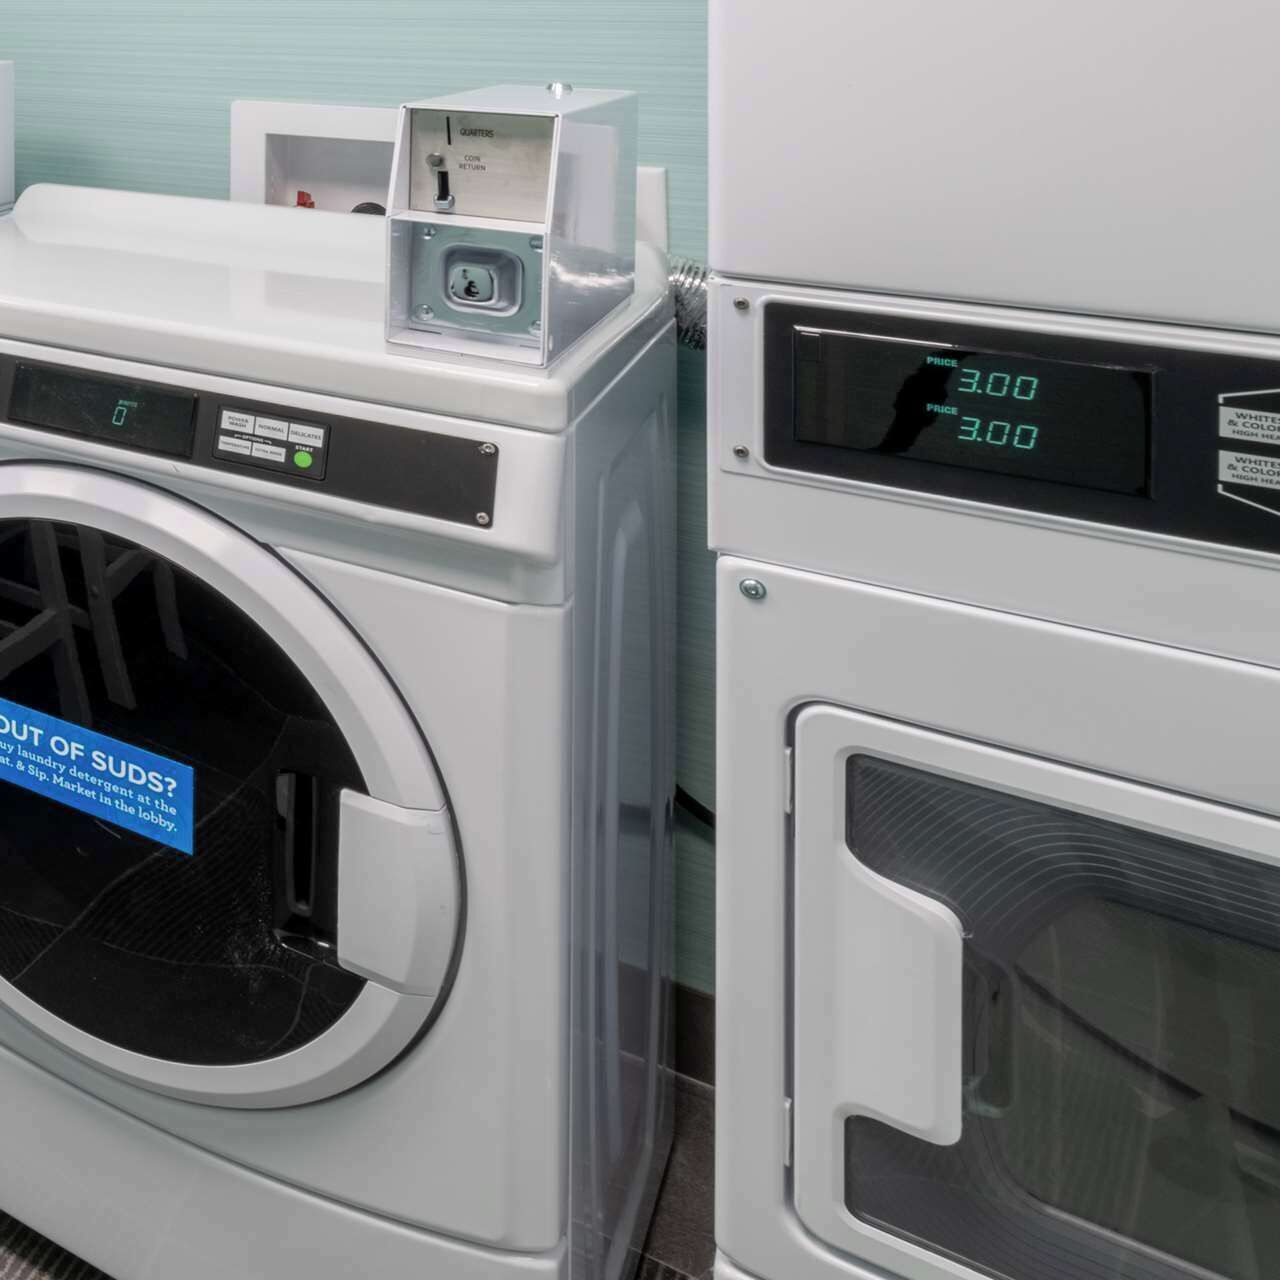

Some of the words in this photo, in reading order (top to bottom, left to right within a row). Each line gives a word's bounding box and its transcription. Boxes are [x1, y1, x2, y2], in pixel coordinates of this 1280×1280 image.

[926, 356, 958, 367] PRICE
[957, 368, 1039, 400] 3.00
[926, 403, 958, 415] PRICE
[112, 406, 127, 426] 0
[258, 423, 285, 434] NORMAL
[1227, 419, 1239, 427] &
[957, 416, 1039, 449] 3.00
[1232, 429, 1258, 437] HIGH
[1227, 463, 1238, 471] &
[1231, 473, 1258, 482] HIGH
[49, 735, 85, 761] OF
[91, 750, 177, 798] SUDS?
[17, 744, 67, 775] laundry
[69, 766, 134, 799] detergent
[137, 792, 152, 808] at
[154, 796, 177, 816] the
[16, 760, 26, 772] &
[28, 763, 50, 782] Sip.
[52, 773, 97, 801] Market
[99, 792, 112, 806] in
[114, 797, 136, 815] the
[138, 807, 178, 832] lobby.
